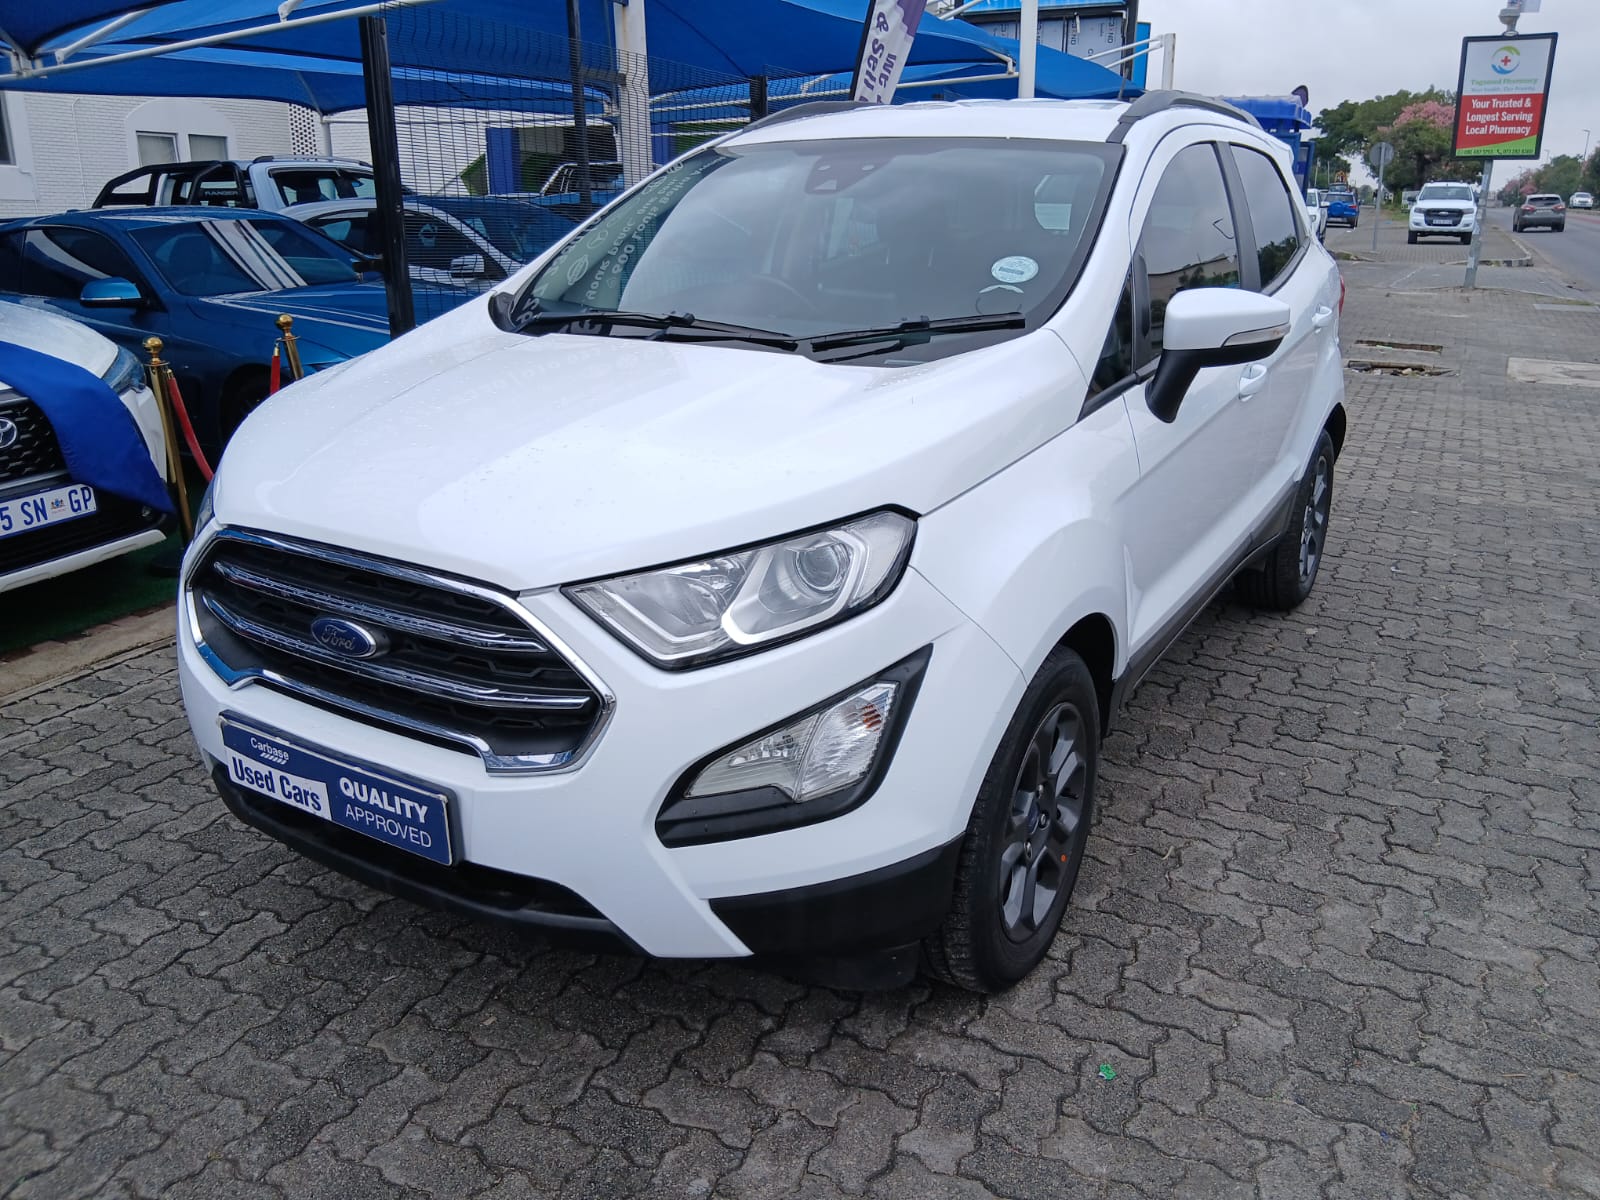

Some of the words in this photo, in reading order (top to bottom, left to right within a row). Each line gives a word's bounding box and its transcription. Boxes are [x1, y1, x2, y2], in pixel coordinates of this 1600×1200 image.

[863, 38, 885, 92] Sell
[1466, 112, 1499, 124] Longest
[1501, 111, 1533, 123] Serving
[1472, 98, 1490, 109] Your
[1492, 98, 1523, 108] Trusted
[1524, 98, 1532, 107] &
[1465, 125, 1488, 135] Local
[1489, 124, 1531, 136] Pharmacy
[20, 497, 48, 526] SN
[68, 486, 92, 513] GP
[321, 624, 356, 650] Ford
[250, 737, 289, 761] Carbase
[232, 757, 275, 793] Used
[279, 775, 322, 811] Cars
[339, 776, 428, 824] QUALITY
[345, 803, 432, 848] APPROVED
